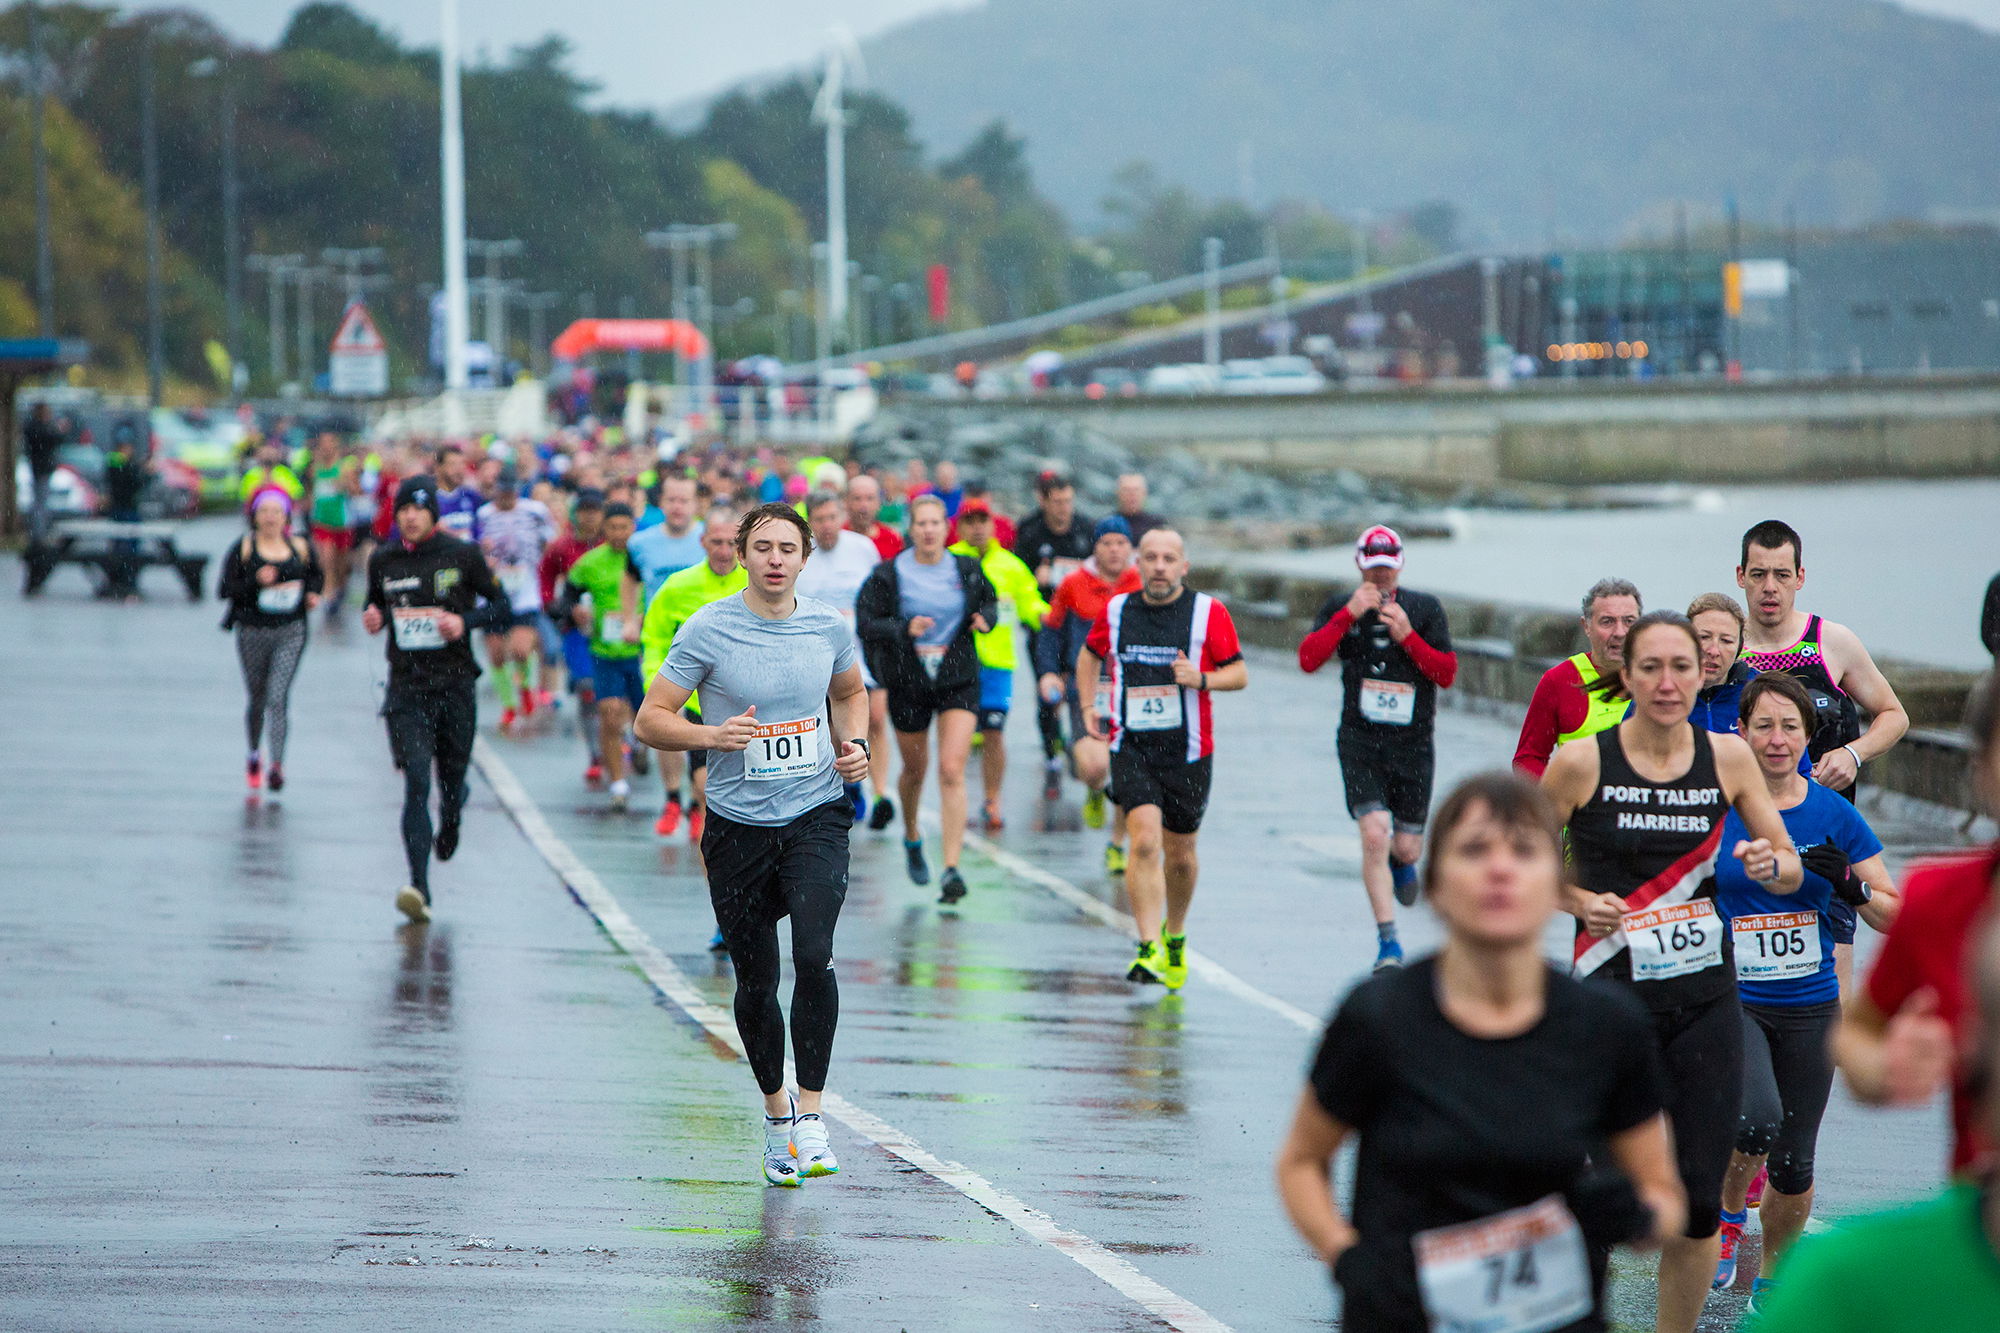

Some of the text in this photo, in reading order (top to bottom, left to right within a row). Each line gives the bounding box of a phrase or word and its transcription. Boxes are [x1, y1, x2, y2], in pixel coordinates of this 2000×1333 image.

[1142, 698, 1164, 714] 43
[1377, 691, 1399, 710] 56
[773, 724, 798, 735] Eirias
[800, 719, 815, 731] 10K
[763, 736, 802, 760] 101
[757, 766, 782, 774] Sanlam
[1602, 785, 1720, 806] PORT TALBOT
[1617, 812, 1710, 833] HARRIERS
[1626, 902, 1712, 930] Porth Eirias 10K
[1735, 912, 1816, 930] Porth Eirias 10K
[1651, 921, 1706, 954] 165
[1755, 929, 1806, 958] 105
[1750, 965, 1778, 973] Sanlam
[1482, 1246, 1540, 1305] 74
